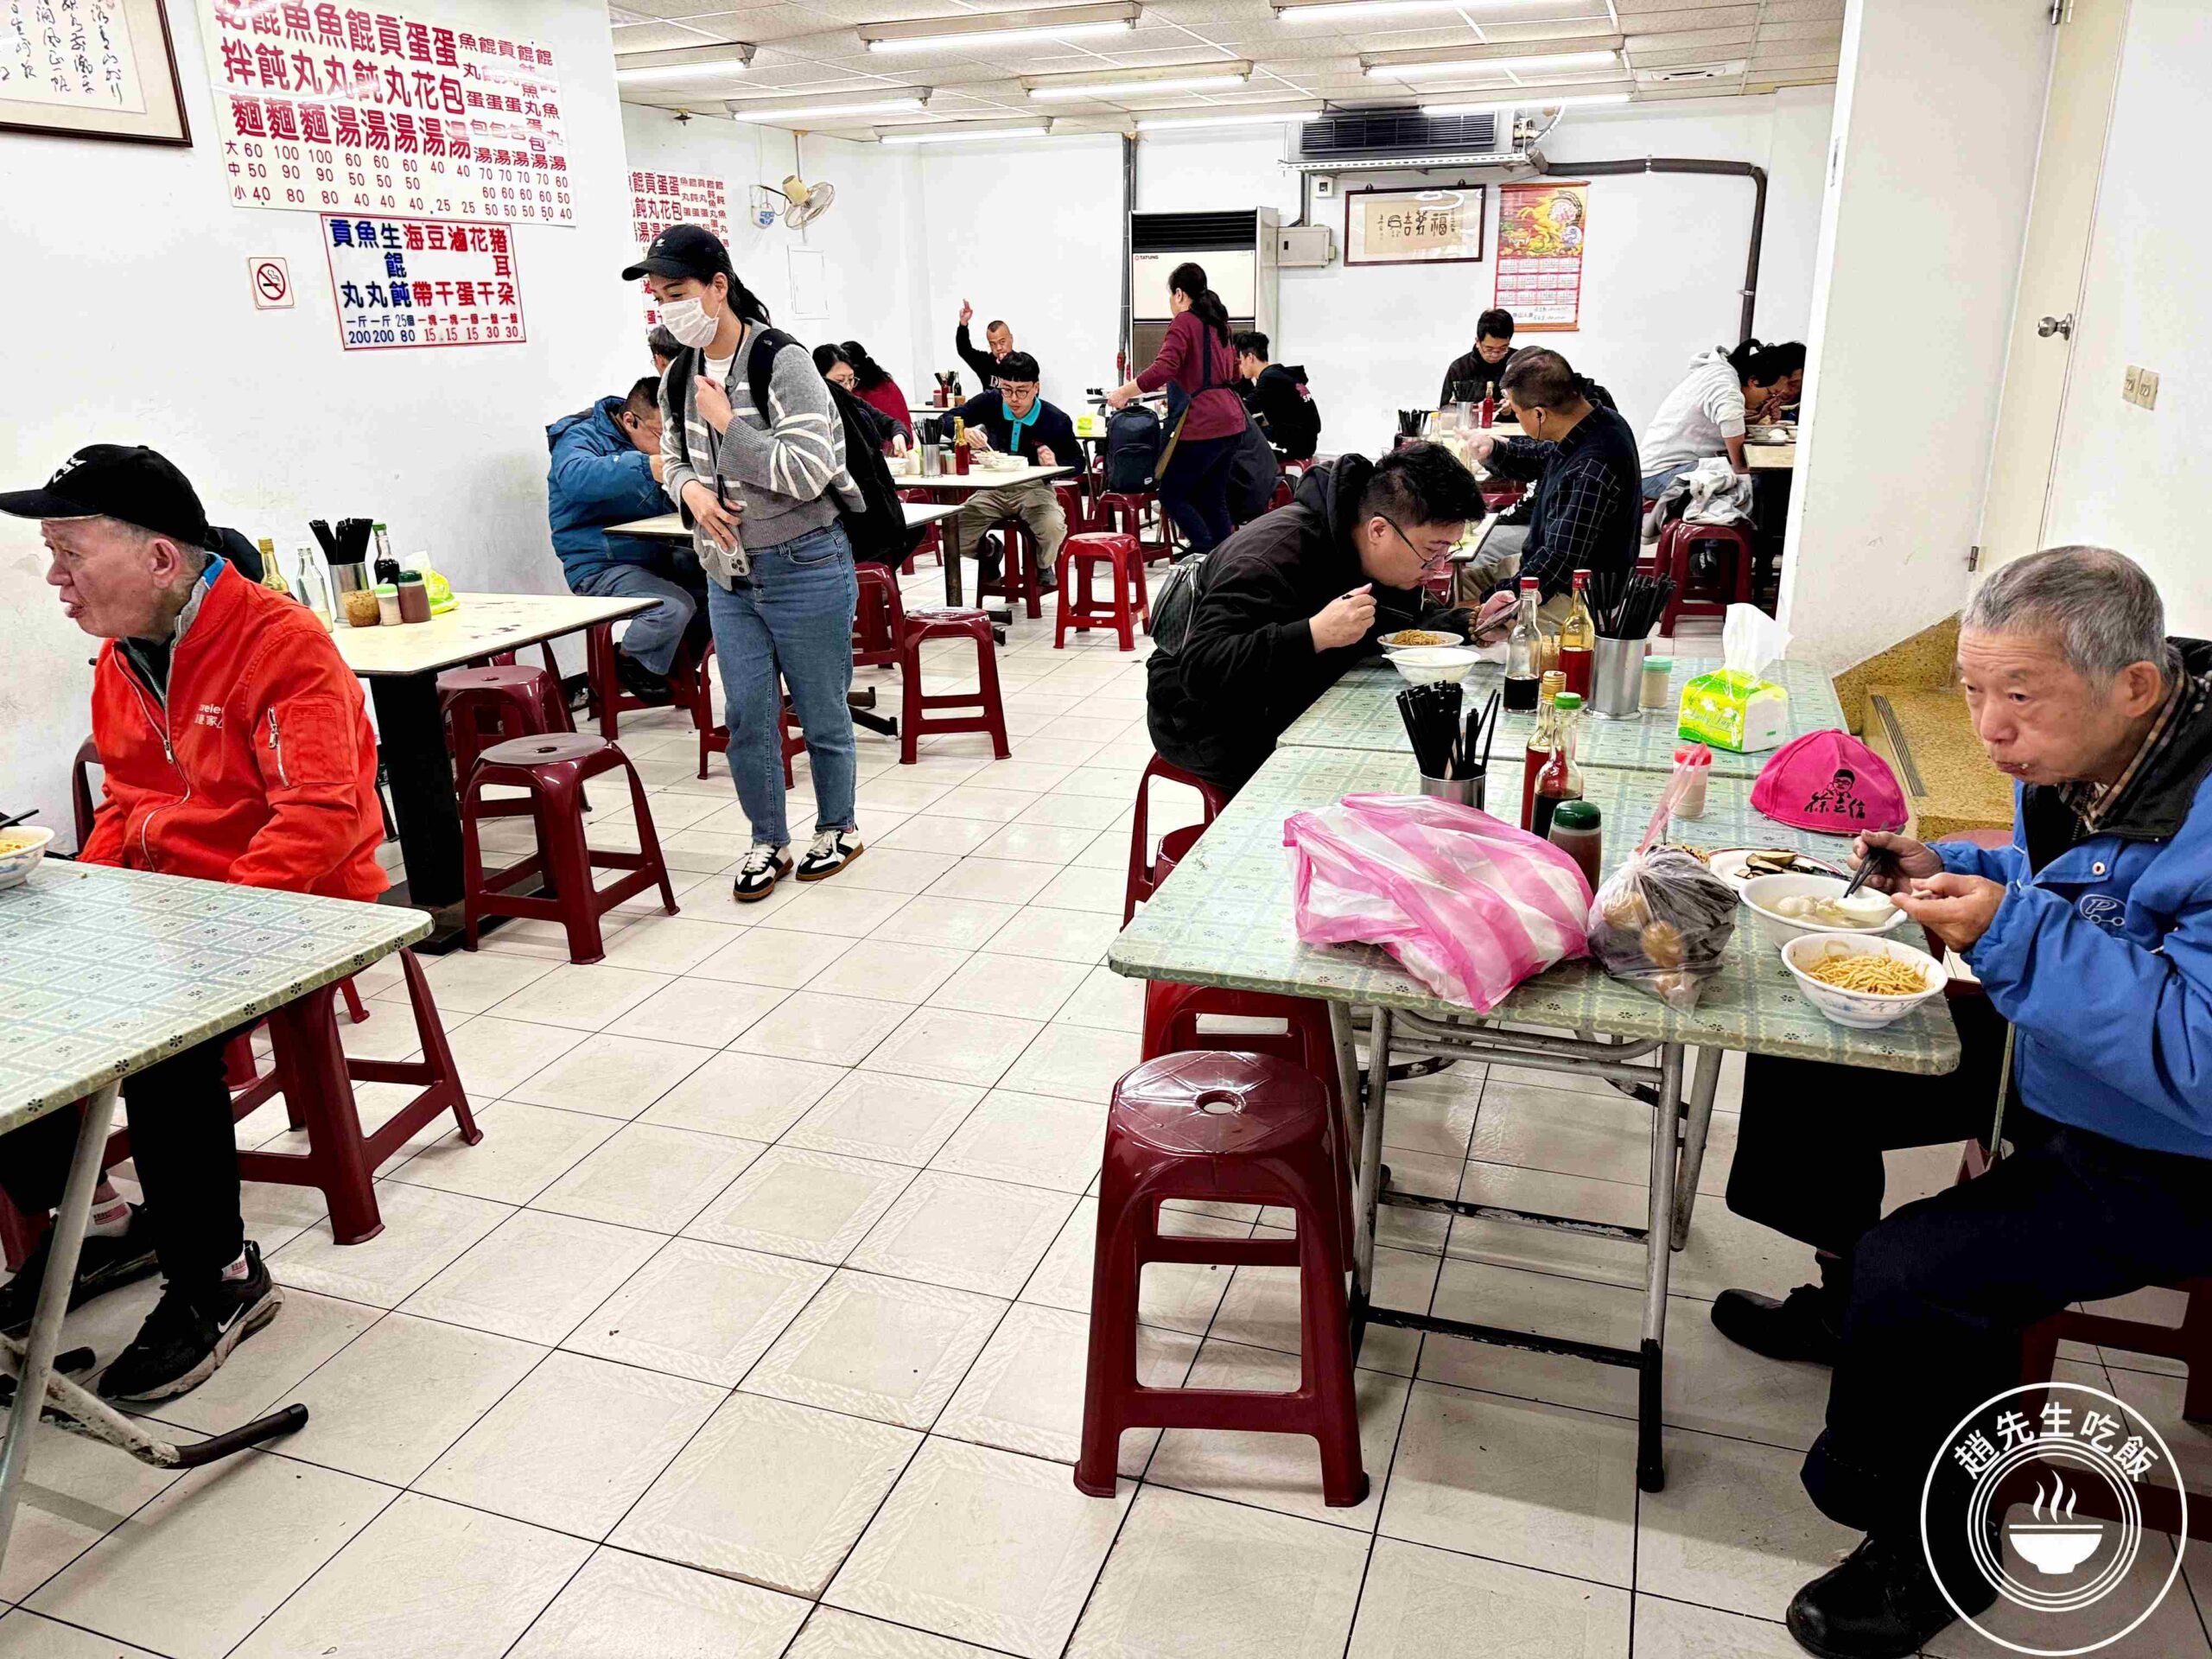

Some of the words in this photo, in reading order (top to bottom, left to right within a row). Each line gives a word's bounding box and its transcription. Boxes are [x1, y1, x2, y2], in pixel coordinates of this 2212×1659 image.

[375, 15, 417, 154] 貢丸湯
[404, 22, 446, 156] 蛋花湯
[226, 140, 238, 156] 大
[245, 143, 263, 157] 60
[275, 145, 299, 160] 100
[308, 149, 332, 163] 100
[346, 154, 361, 167] 60
[374, 156, 389, 168] 60
[403, 159, 417, 172] 60
[431, 162, 444, 174] 40
[457, 165, 470, 177] 40
[480, 168, 493, 180] 70
[499, 169, 512, 181] 70
[518, 172, 530, 183] 70
[537, 174, 549, 185] 70
[556, 176, 568, 188] 60
[228, 162, 240, 176] 中
[248, 164, 266, 178] 50
[282, 165, 300, 179] 90
[316, 168, 334, 181] 90
[349, 173, 365, 186] 50
[377, 175, 391, 188] 50
[406, 177, 420, 189] 50
[483, 187, 495, 199] 60
[502, 188, 514, 199] 60
[520, 188, 532, 200] 60
[539, 191, 551, 202] 60
[558, 193, 569, 204] 50
[234, 185, 246, 200] 小
[253, 187, 270, 200] 40
[287, 188, 304, 203] 80
[321, 191, 339, 204] 80
[354, 194, 369, 207] 40
[380, 195, 395, 208] 40
[410, 198, 423, 210] 40
[436, 199, 450, 211] 25
[461, 201, 475, 213] 25
[486, 204, 498, 215] 50
[505, 205, 516, 216] 50
[523, 206, 534, 217] 50
[542, 207, 553, 218] 50
[561, 208, 571, 219] 40
[330, 219, 364, 308] 貢丸
[355, 221, 388, 308] 魚丸
[381, 223, 411, 308] 生餛飩
[403, 224, 432, 307] 海帶
[426, 226, 454, 306] 豆干
[448, 226, 476, 306] 滷蛋
[468, 227, 494, 306] 花干
[346, 315, 367, 327] 一斤
[371, 315, 391, 327] 一斤
[349, 331, 371, 343] 200
[373, 330, 394, 342] 200
[401, 330, 415, 341] 80
[424, 328, 435, 341] 15
[446, 327, 457, 340] 15
[467, 327, 479, 340] 15
[486, 327, 499, 338] 30
[505, 326, 518, 337] 30
